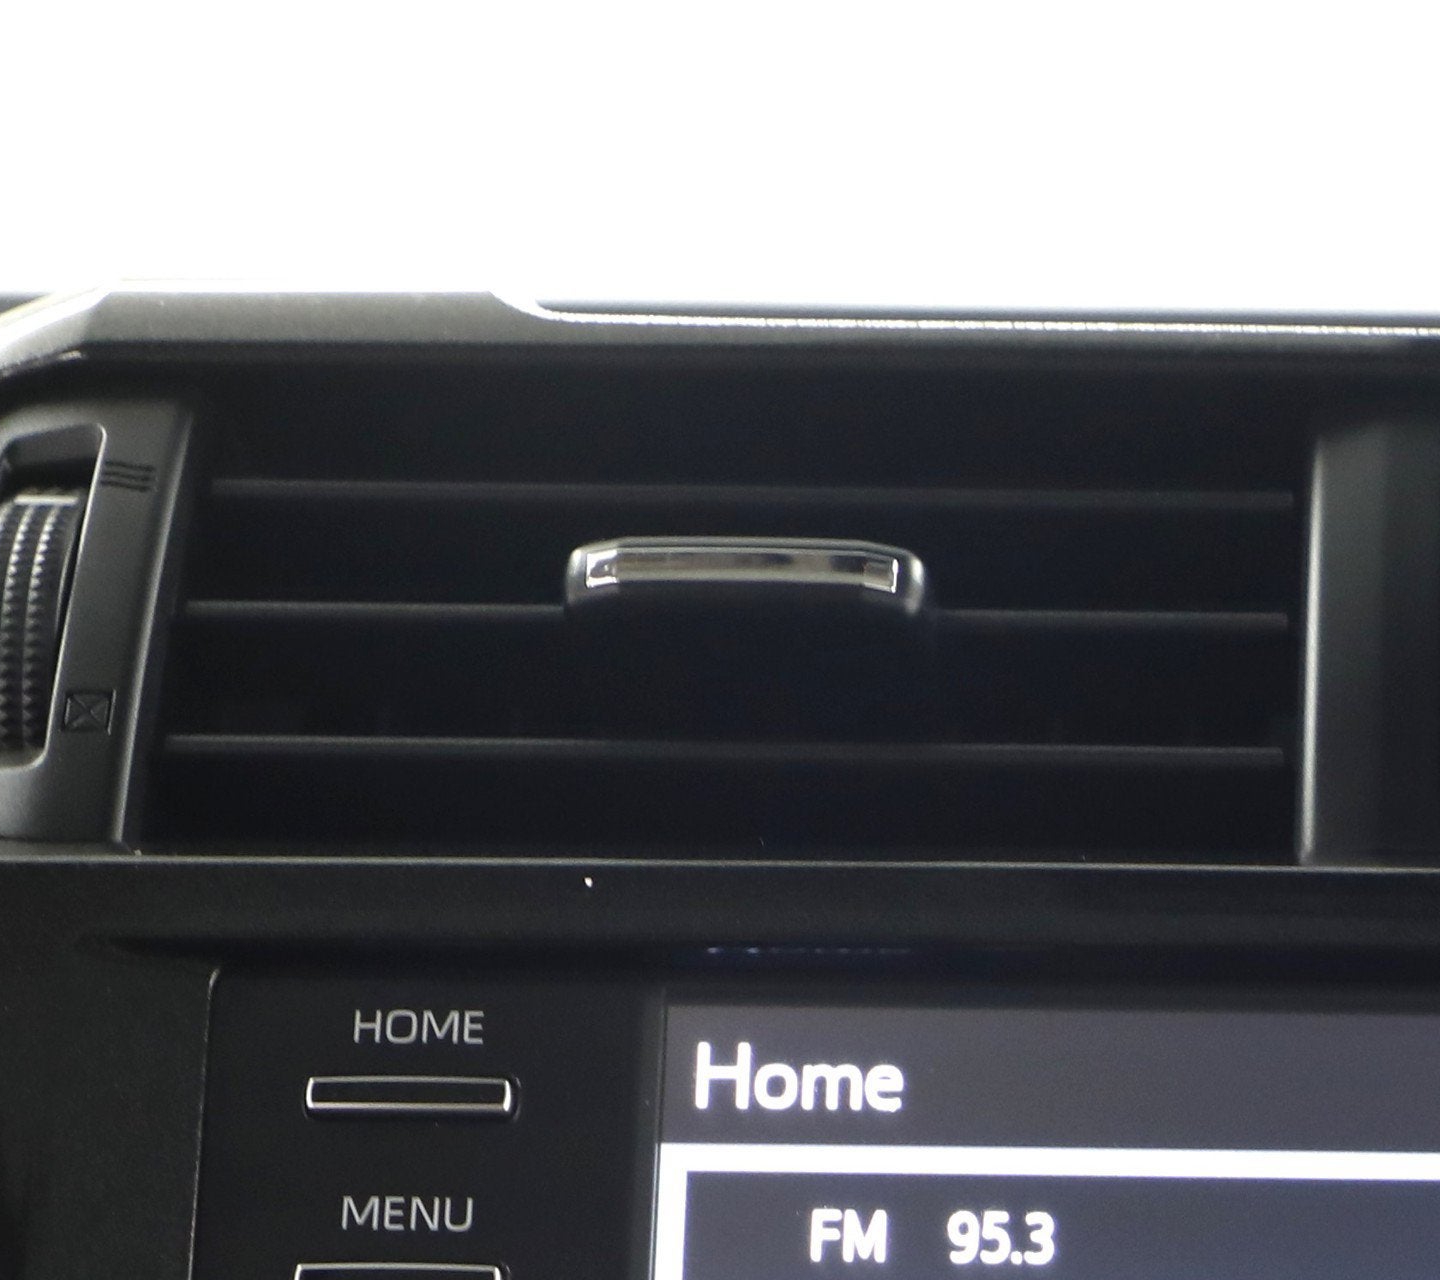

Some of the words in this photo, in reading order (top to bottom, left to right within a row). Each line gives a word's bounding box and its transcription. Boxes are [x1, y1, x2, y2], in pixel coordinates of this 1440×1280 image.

[353, 1009, 485, 1045] HOME
[692, 1040, 906, 1114] Home
[340, 1195, 474, 1232] MENU
[808, 1206, 890, 1264] FM
[945, 1209, 1057, 1267] 95.3
